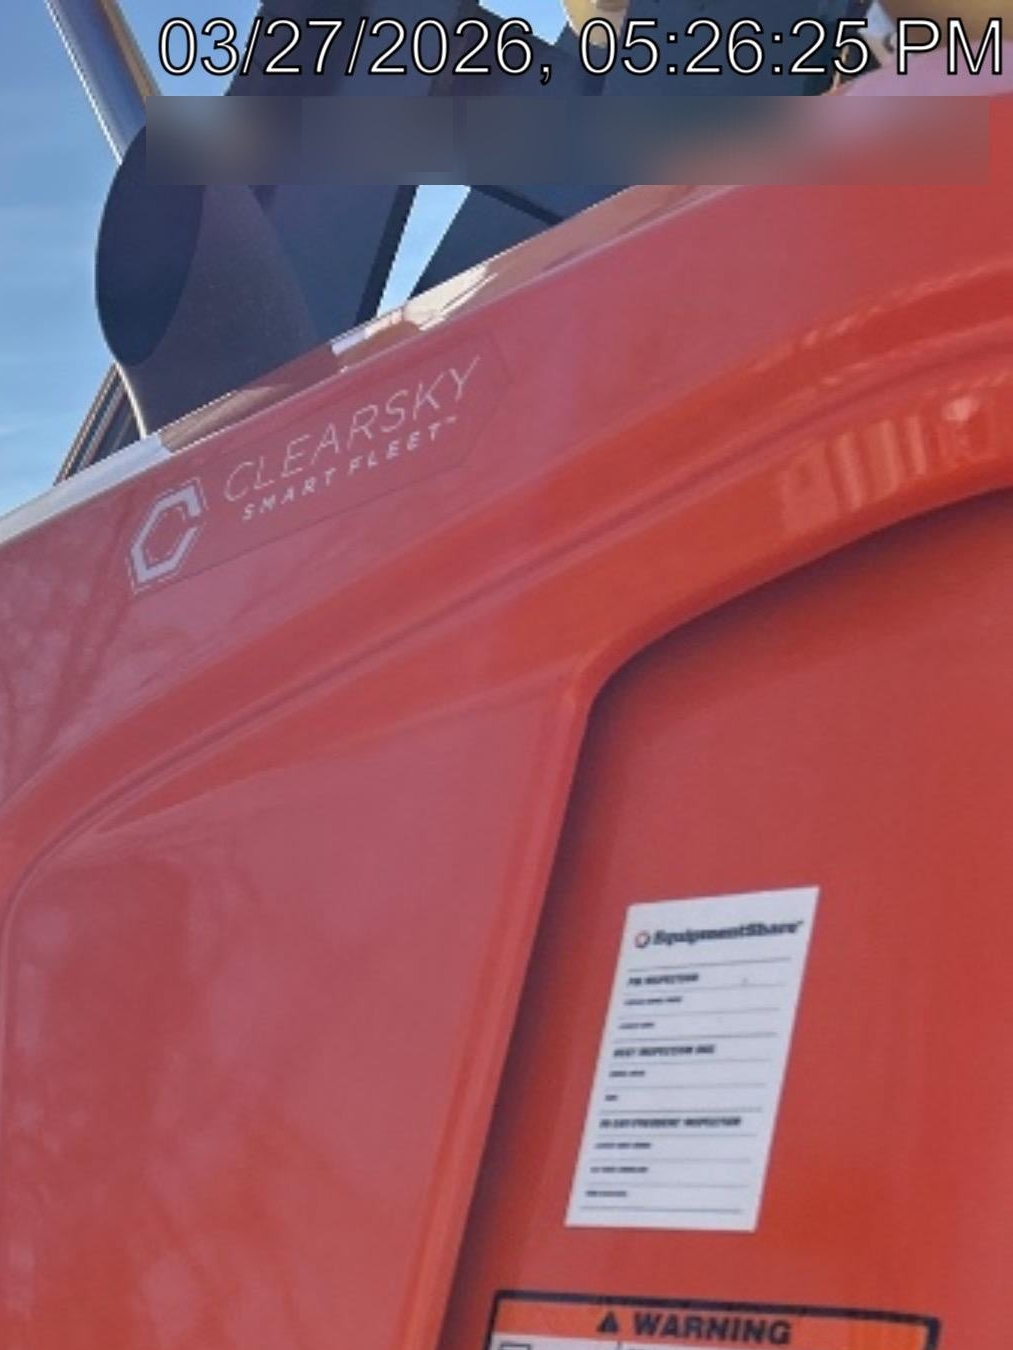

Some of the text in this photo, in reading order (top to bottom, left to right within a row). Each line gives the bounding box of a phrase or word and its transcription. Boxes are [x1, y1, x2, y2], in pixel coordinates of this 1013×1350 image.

[223, 355, 482, 503] CLEARSKY
[242, 417, 443, 521] SMART FLEET
[630, 1311, 792, 1347] WARNING
